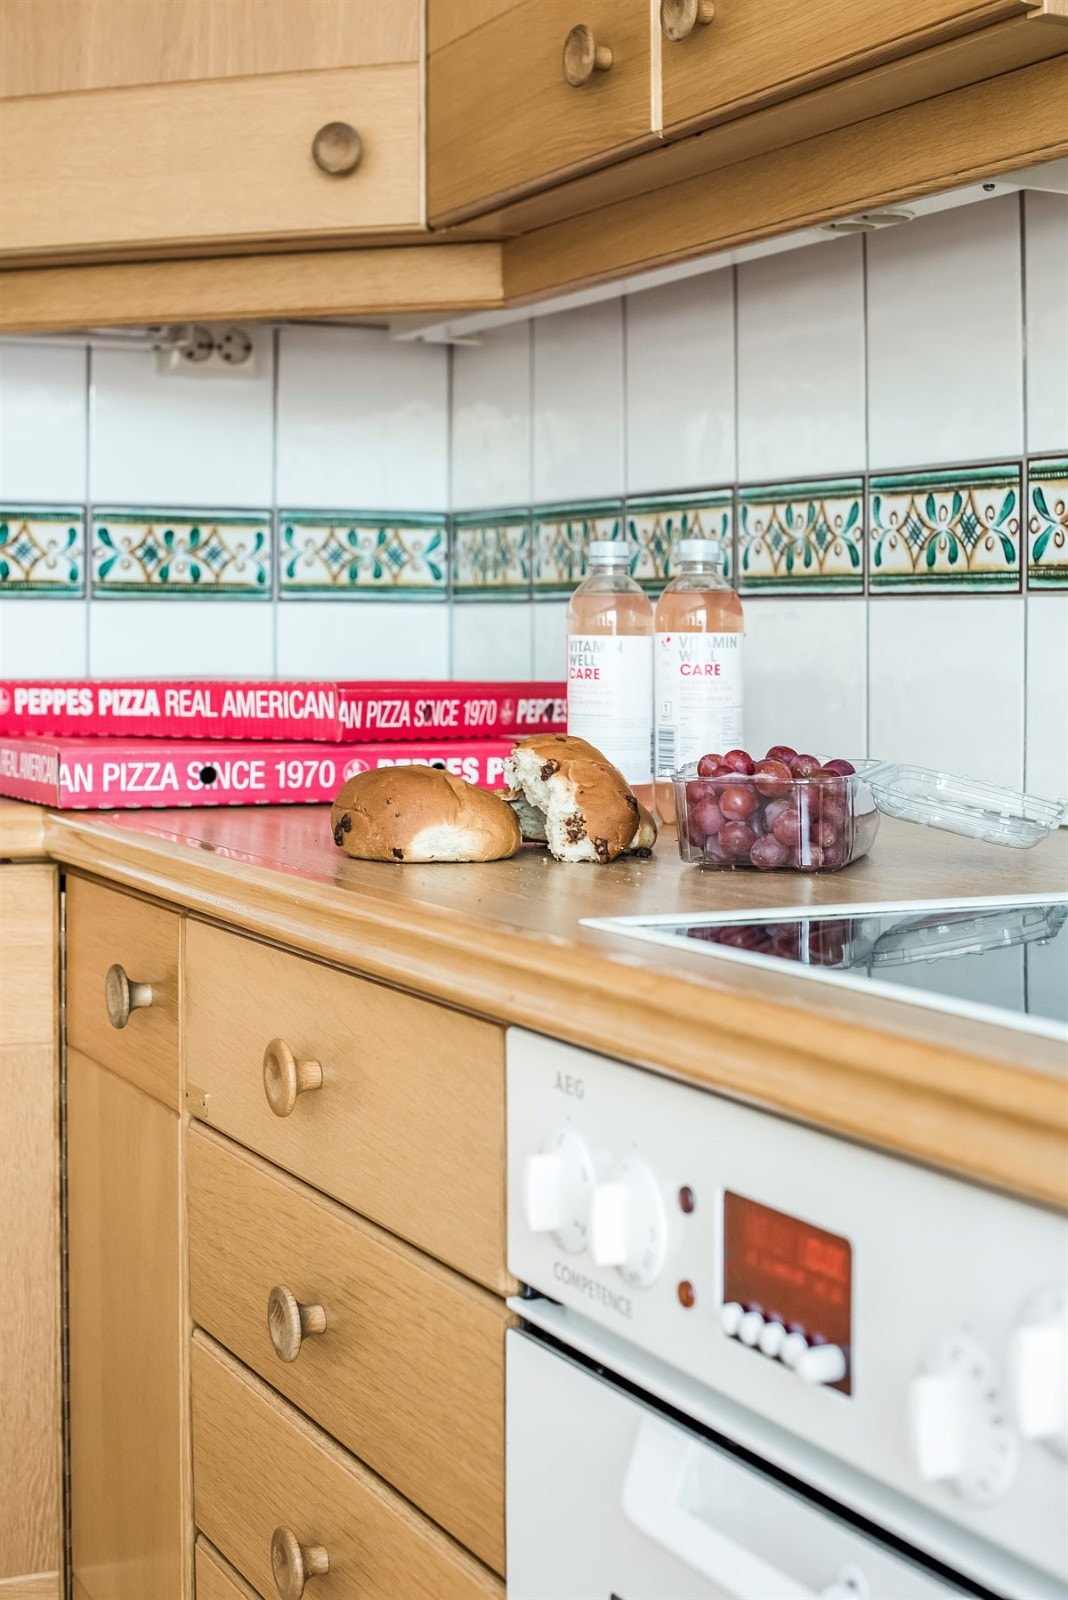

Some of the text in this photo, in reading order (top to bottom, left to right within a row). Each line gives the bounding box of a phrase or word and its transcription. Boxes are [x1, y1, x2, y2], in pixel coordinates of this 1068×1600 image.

[569, 654, 597, 667] WELL
[569, 668, 601, 680] CARE
[680, 664, 721, 676] CARE
[14, 688, 335, 720] PEPPES PIZZA REAL AMERICAN
[338, 700, 363, 729] AN
[366, 700, 411, 728] PIZZA
[463, 699, 498, 726] 1970
[60, 763, 93, 793] AN
[102, 762, 180, 792] PIZZA
[274, 759, 336, 789] 1970
[553, 1070, 585, 1100] AEG
[553, 1261, 634, 1321] COMPETENCE
